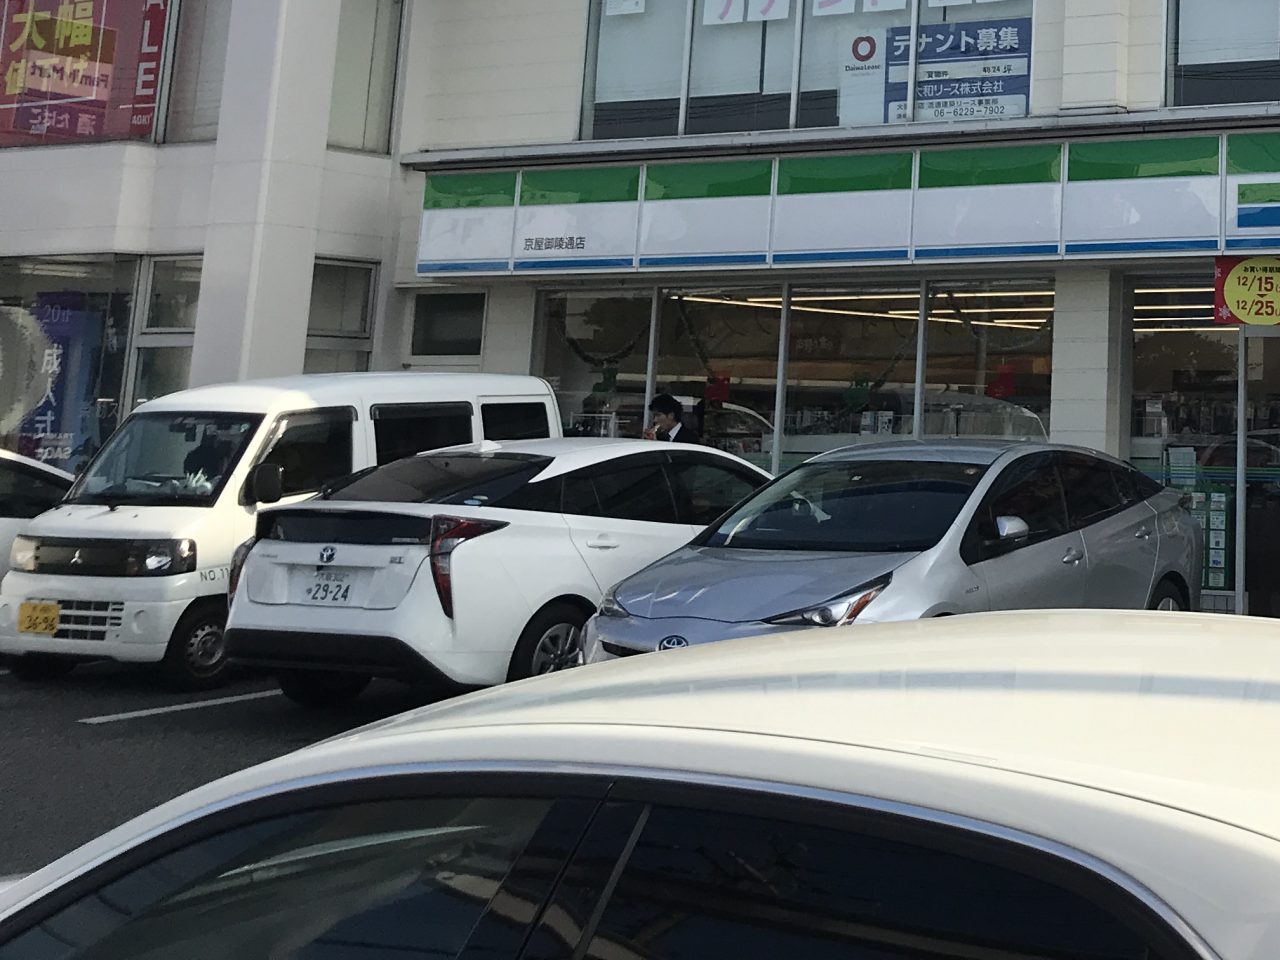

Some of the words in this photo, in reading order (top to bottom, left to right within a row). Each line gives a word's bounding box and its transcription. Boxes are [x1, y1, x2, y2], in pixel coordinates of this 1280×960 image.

[893, 26, 1020, 56] テナント募集
[933, 105, 1006, 118] 06-6229-7902
[311, 583, 351, 602] 29-24
